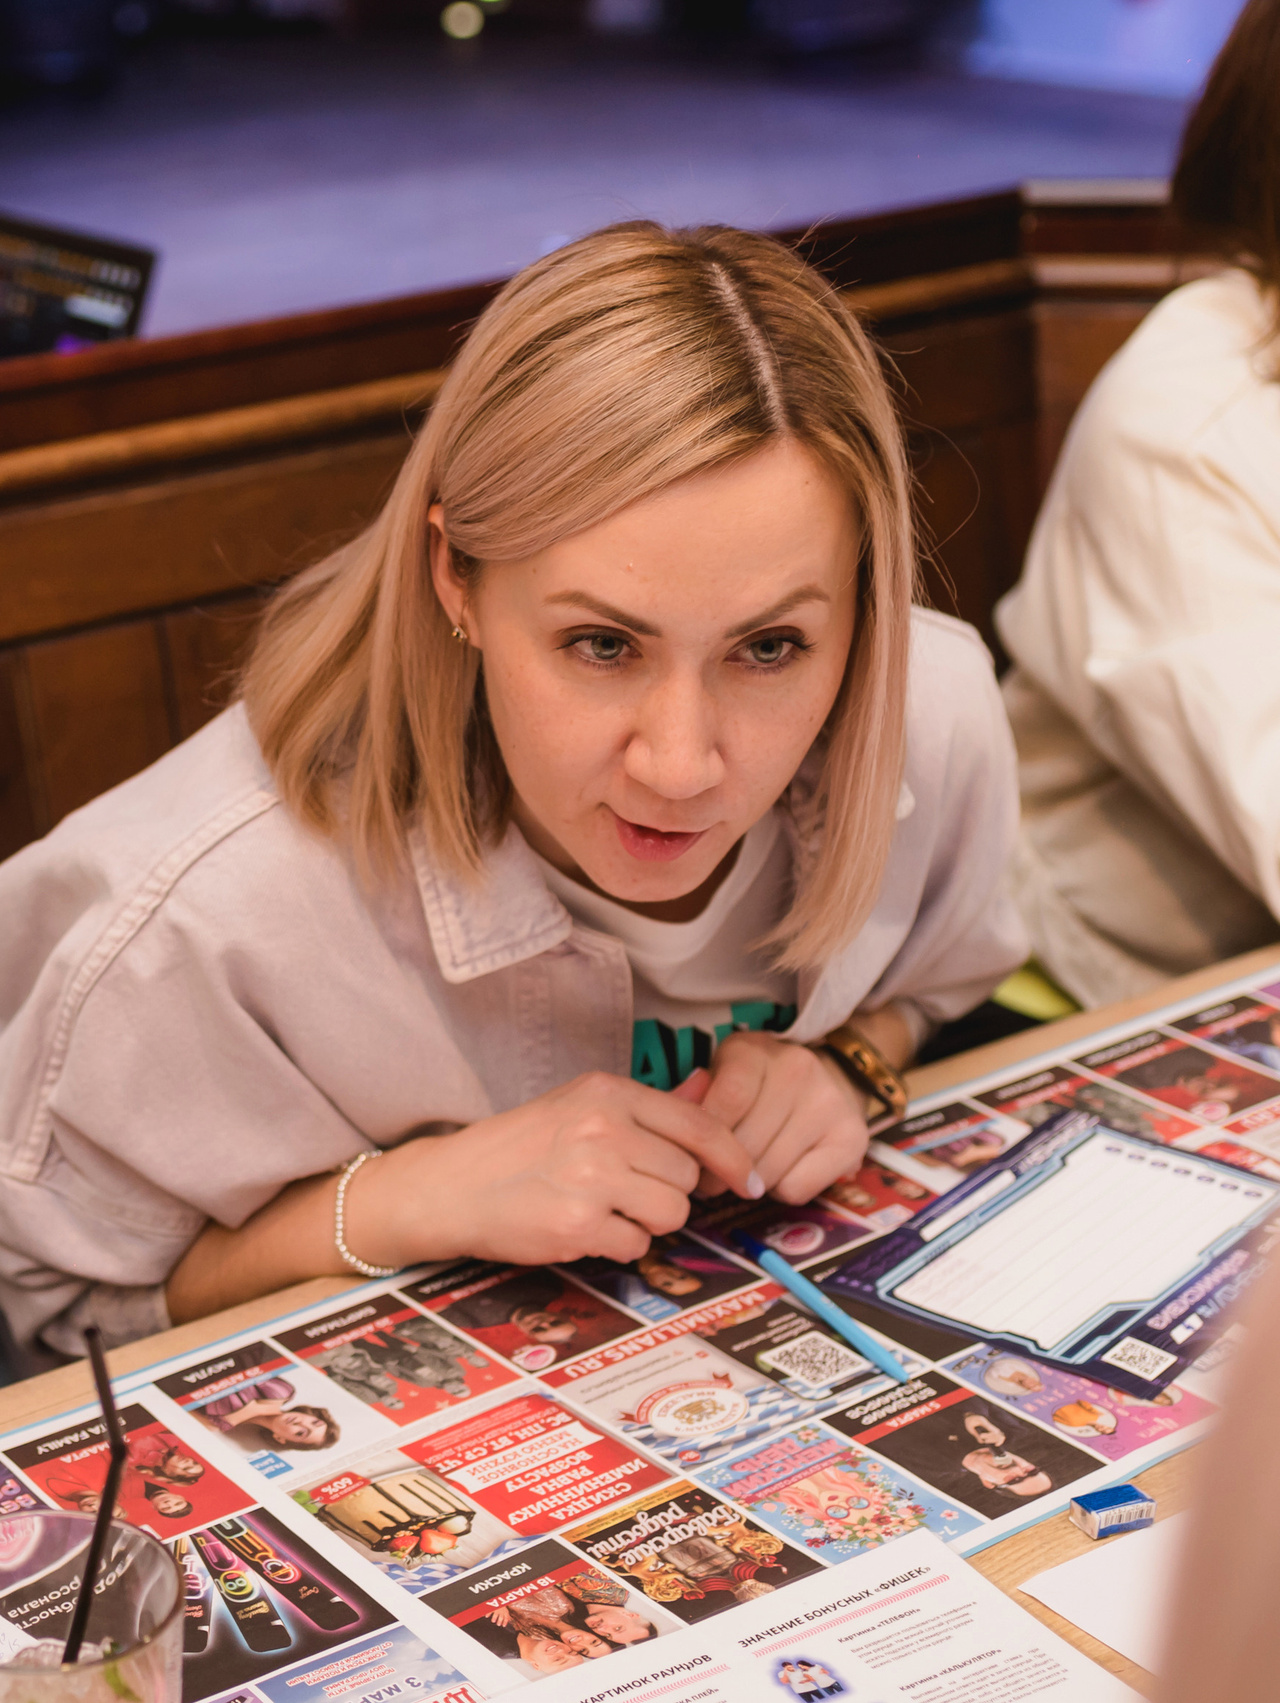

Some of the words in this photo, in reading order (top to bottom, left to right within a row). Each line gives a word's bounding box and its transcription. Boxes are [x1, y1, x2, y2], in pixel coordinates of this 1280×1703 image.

[560, 1287, 767, 1378] MAXIMILIANS.RU
[182, 1358, 236, 1384] АКУЛА
[189, 1371, 246, 1400] АПРЕЛЯ
[857, 1386, 938, 1426] ВЛАДИМИР
[883, 1403, 934, 1429] МАРТА
[927, 1399, 942, 1409] 5
[506, 1422, 548, 1441] ПН,
[537, 1410, 574, 1428] ВС,
[34, 1428, 90, 1455] FAMILY
[58, 1440, 109, 1464] МАРТА
[455, 1445, 492, 1462] СР,
[481, 1434, 516, 1451] ВТ,
[518, 1429, 573, 1454] МЕНЮ
[556, 1437, 584, 1451] НА
[430, 1456, 465, 1473] ЧТ
[464, 1450, 523, 1476] КУХНИ
[474, 1446, 562, 1484] ОСНОВНОЕ
[717, 1436, 847, 1502] ЖЕНСКИЙ
[726, 1436, 805, 1477] ДЕНЬ
[497, 1449, 595, 1492] ВОЗРАСТУ
[527, 1464, 595, 1496] РАВНА
[754, 1454, 843, 1498] МЕЖДУНАРОДНЫЙ
[319, 1475, 354, 1497] 60%
[499, 1457, 650, 1525] ИМЕНИННИКУ
[546, 1480, 635, 1521] СКИДКА
[582, 1498, 692, 1559] радости
[612, 1503, 744, 1566] Баварские
[466, 1561, 533, 1594] КРАСКИ
[534, 1575, 556, 1587] 18
[484, 1582, 539, 1608] МАРТА
[737, 1616, 805, 1649] ЗНАЧЕНИЕ
[802, 1588, 874, 1622] БОНУСНЫХ
[871, 1563, 933, 1594] «ФИШЕК»
[836, 1624, 877, 1644] Картинка
[875, 1606, 922, 1628] «ТЕЛЕФОН»
[342, 1645, 382, 1663] ЛЮБИМОЙ
[344, 1650, 387, 1669] КОНКУРСЫ
[285, 1659, 346, 1686] РАДИОСТАНЦИИ
[304, 1668, 341, 1685] ПОДАРКИ
[346, 1667, 396, 1689] ПОПУЛЯРНЫЕ
[403, 1676, 423, 1688] 3
[898, 1673, 939, 1692] Картинка
[937, 1647, 1003, 1676] «КАЛЬКУЛЯТОР»
[325, 1686, 349, 1698] ХИТЫ
